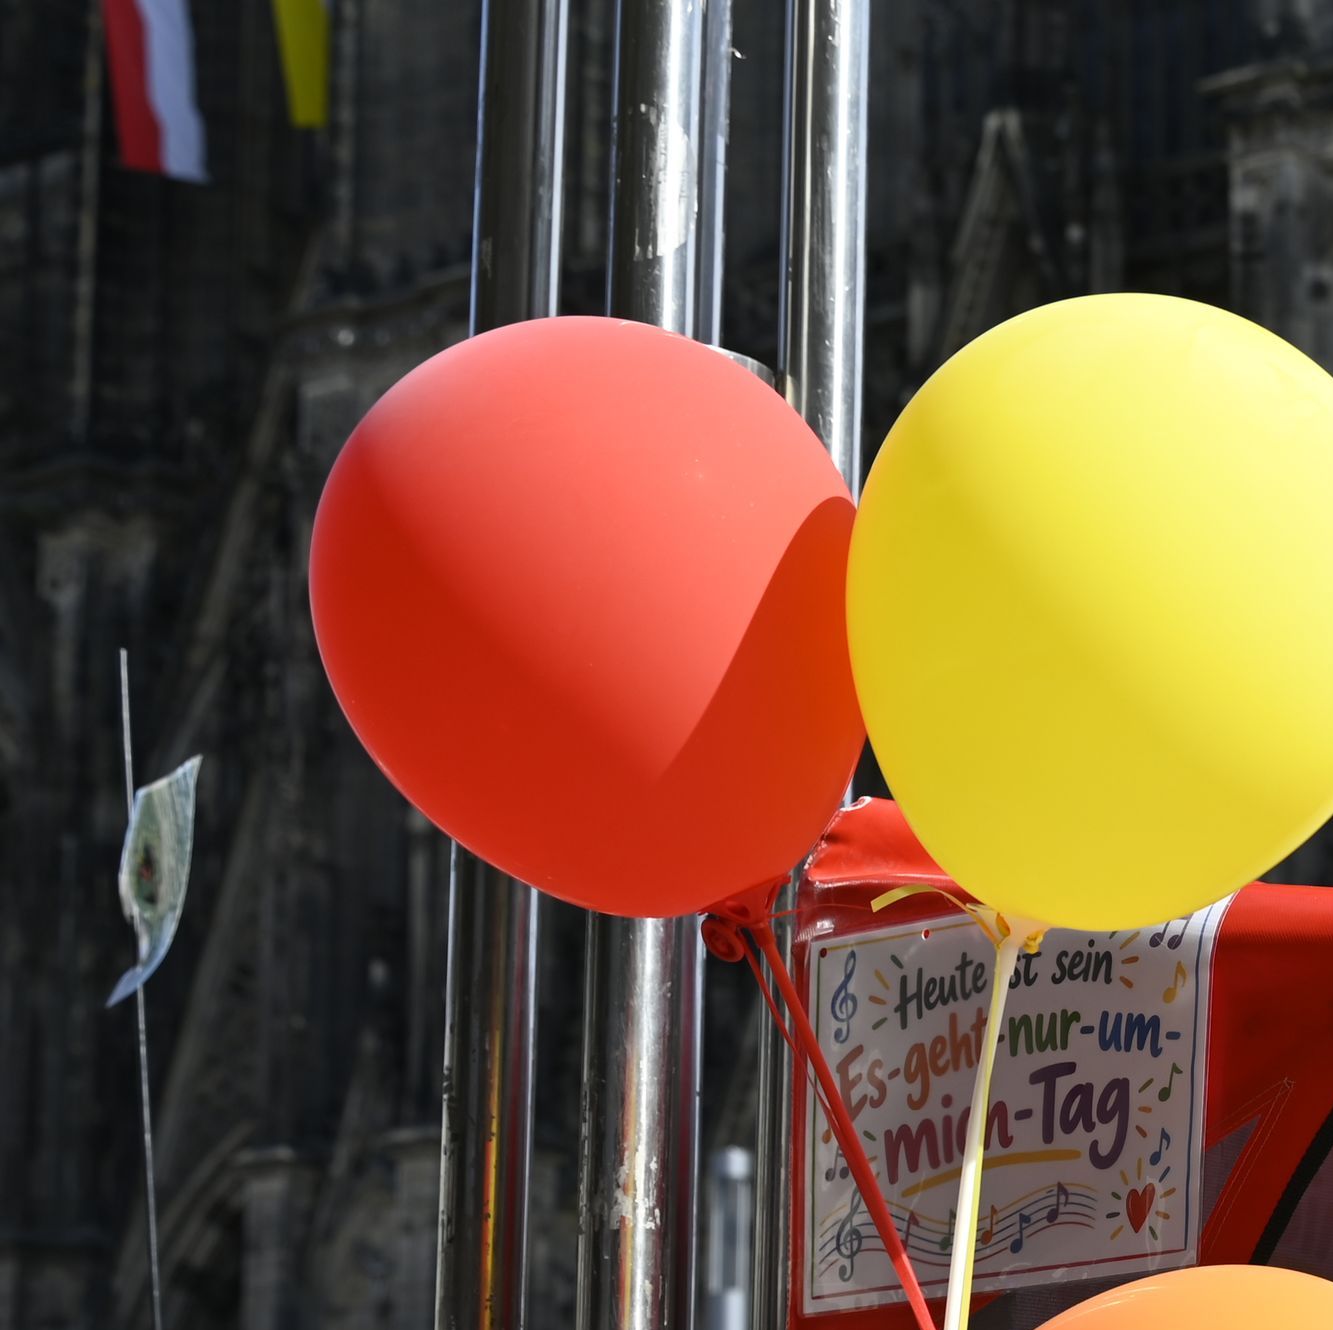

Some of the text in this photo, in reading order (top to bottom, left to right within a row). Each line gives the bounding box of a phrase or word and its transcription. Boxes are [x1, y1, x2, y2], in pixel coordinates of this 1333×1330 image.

[895, 940, 1113, 1030] Heute st sein
